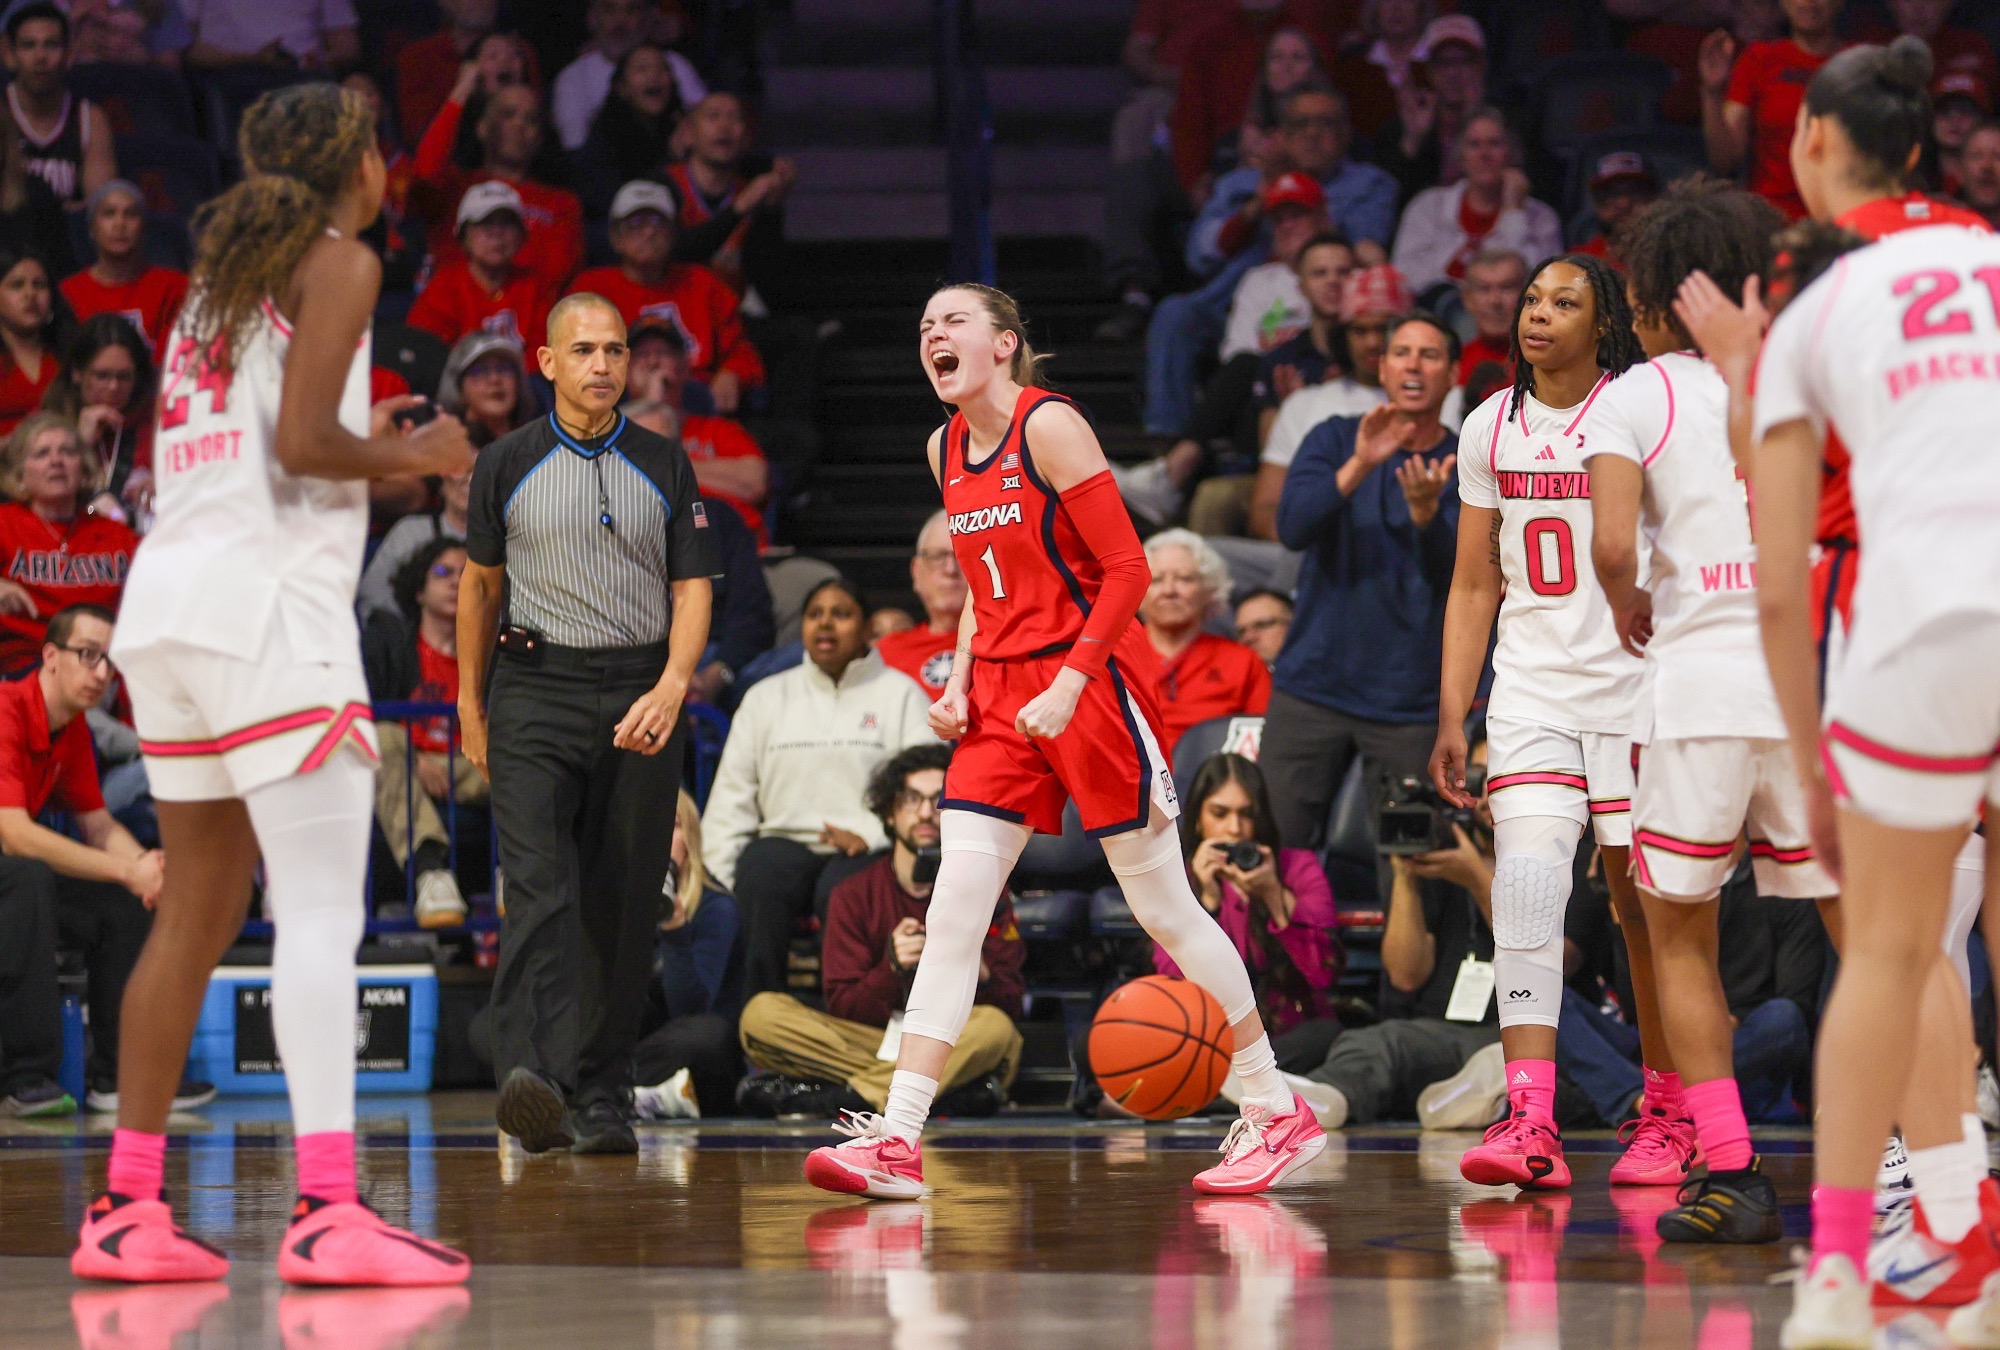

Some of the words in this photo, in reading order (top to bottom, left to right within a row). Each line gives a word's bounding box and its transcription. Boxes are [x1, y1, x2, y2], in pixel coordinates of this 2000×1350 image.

[1892, 265, 2000, 342] 21
[160, 334, 234, 431] 24
[949, 502, 1023, 536] ARIZONA
[1523, 516, 1578, 597] 0
[979, 543, 1008, 599] 1
